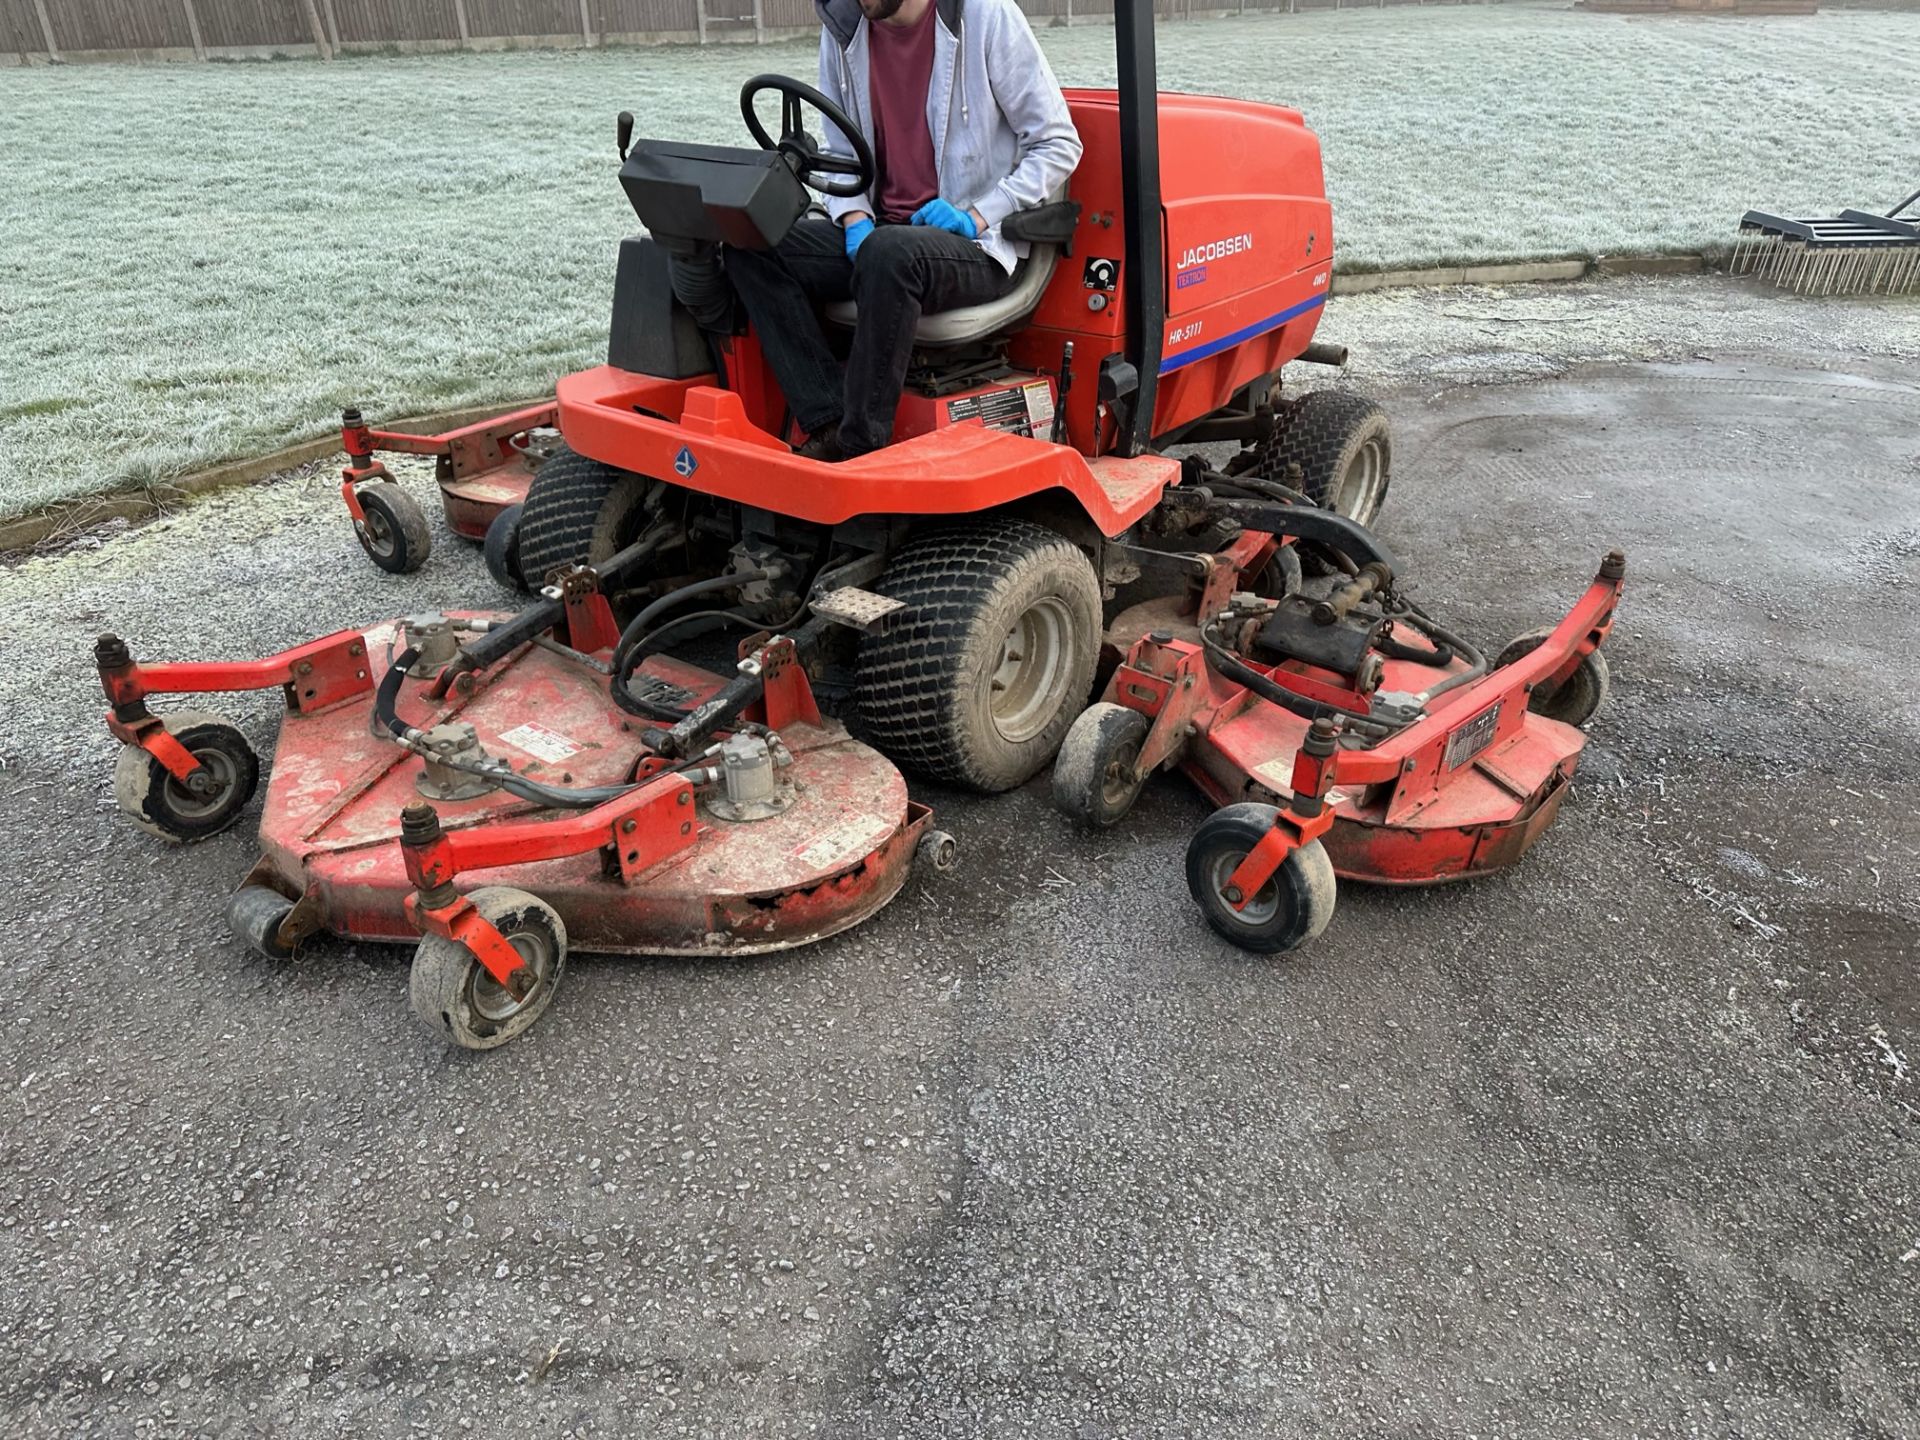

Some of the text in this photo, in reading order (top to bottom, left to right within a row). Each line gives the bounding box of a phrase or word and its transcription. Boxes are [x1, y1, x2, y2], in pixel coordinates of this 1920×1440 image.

[1176, 232, 1252, 270] JACOBSEN
[1178, 267, 1206, 288] TEXTRON
[1168, 320, 1203, 346] HR-5111
